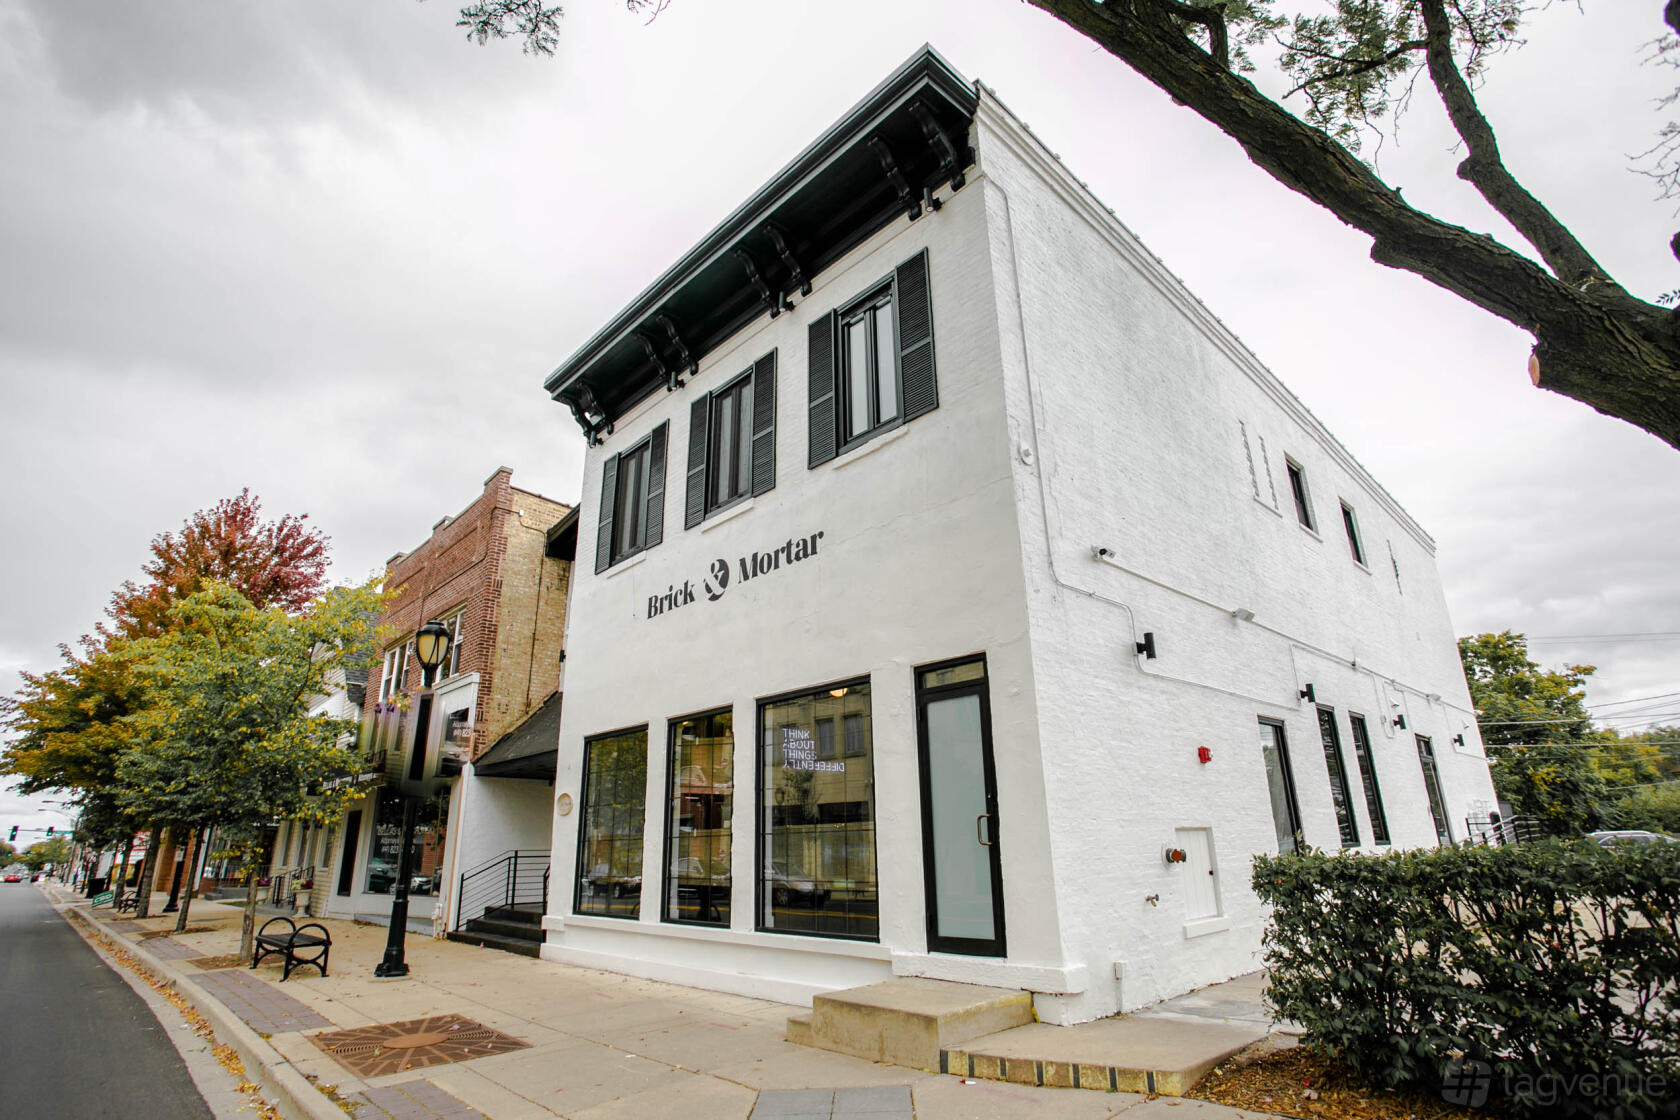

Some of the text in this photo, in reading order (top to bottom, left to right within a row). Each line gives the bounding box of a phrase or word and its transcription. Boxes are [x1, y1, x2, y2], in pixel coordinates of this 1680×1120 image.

[647, 531, 825, 619] Brick & Mortar
[782, 728, 810, 739] THINK
[783, 739, 815, 750] ABOUT
[783, 749, 817, 760] THINGS
[783, 760, 845, 772] DIFFERENTLY
